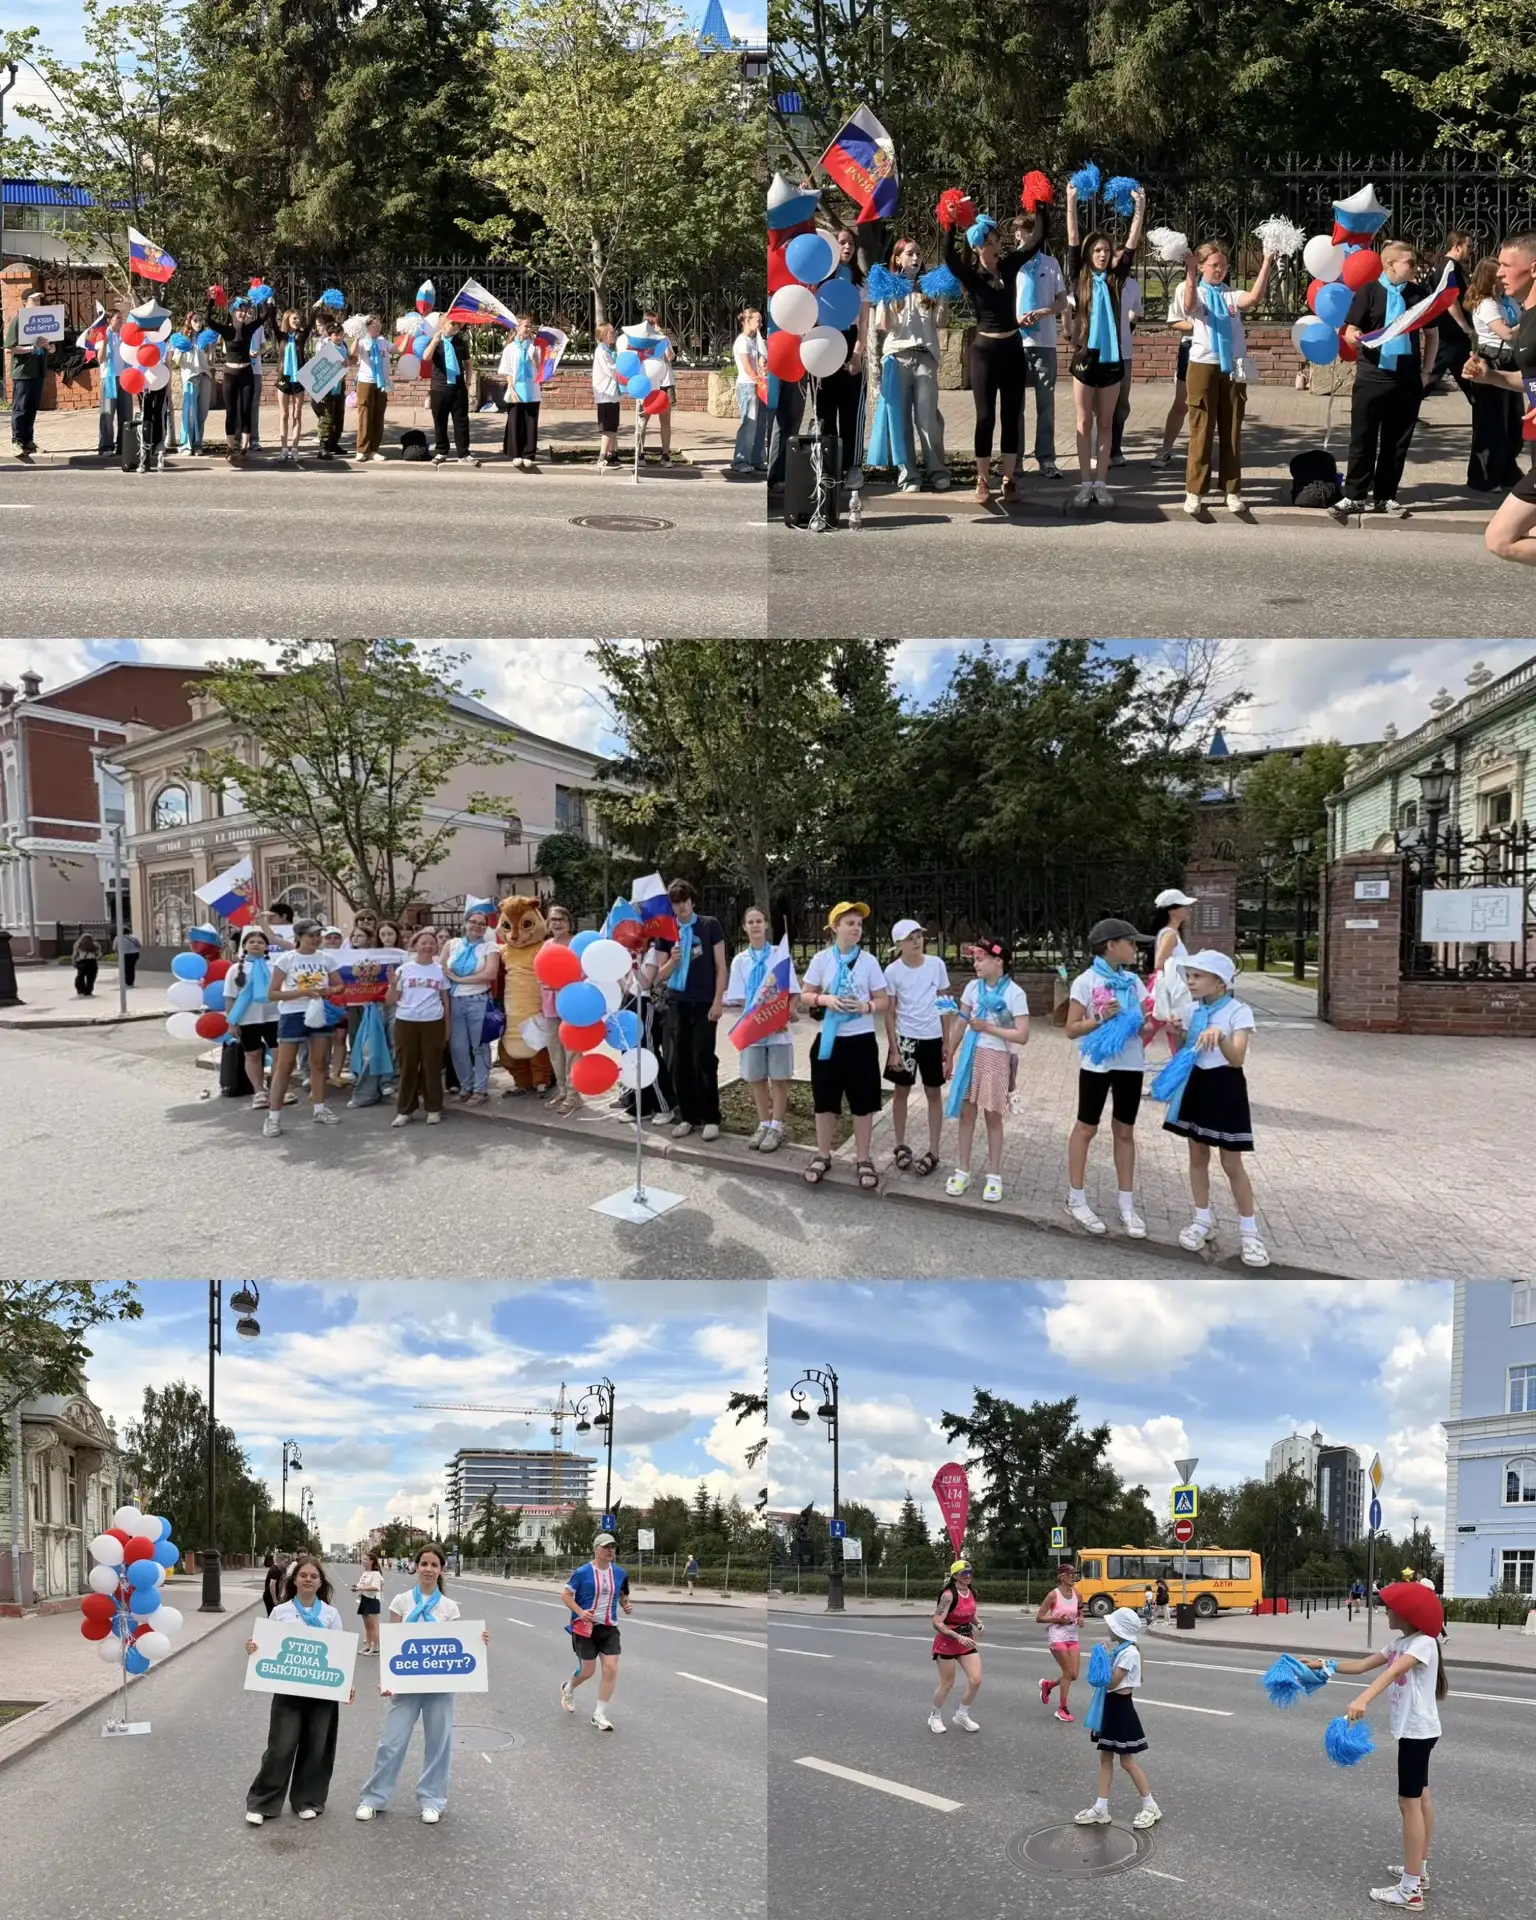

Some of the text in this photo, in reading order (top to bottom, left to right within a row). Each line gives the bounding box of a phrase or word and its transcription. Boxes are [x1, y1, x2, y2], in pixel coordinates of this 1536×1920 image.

[844, 166, 874, 193] РОСС
[37, 316, 53, 324] куда
[37, 323, 58, 331] бегут?
[1213, 1580, 1233, 1588] ДЕТИ
[288, 1641, 322, 1655] УТЮГ
[407, 1642, 457, 1656] А куда
[284, 1653, 320, 1667] ДОМА
[395, 1656, 471, 1672] все бегут?
[261, 1662, 341, 1682] ВЫКЛЮЧИЛ?
